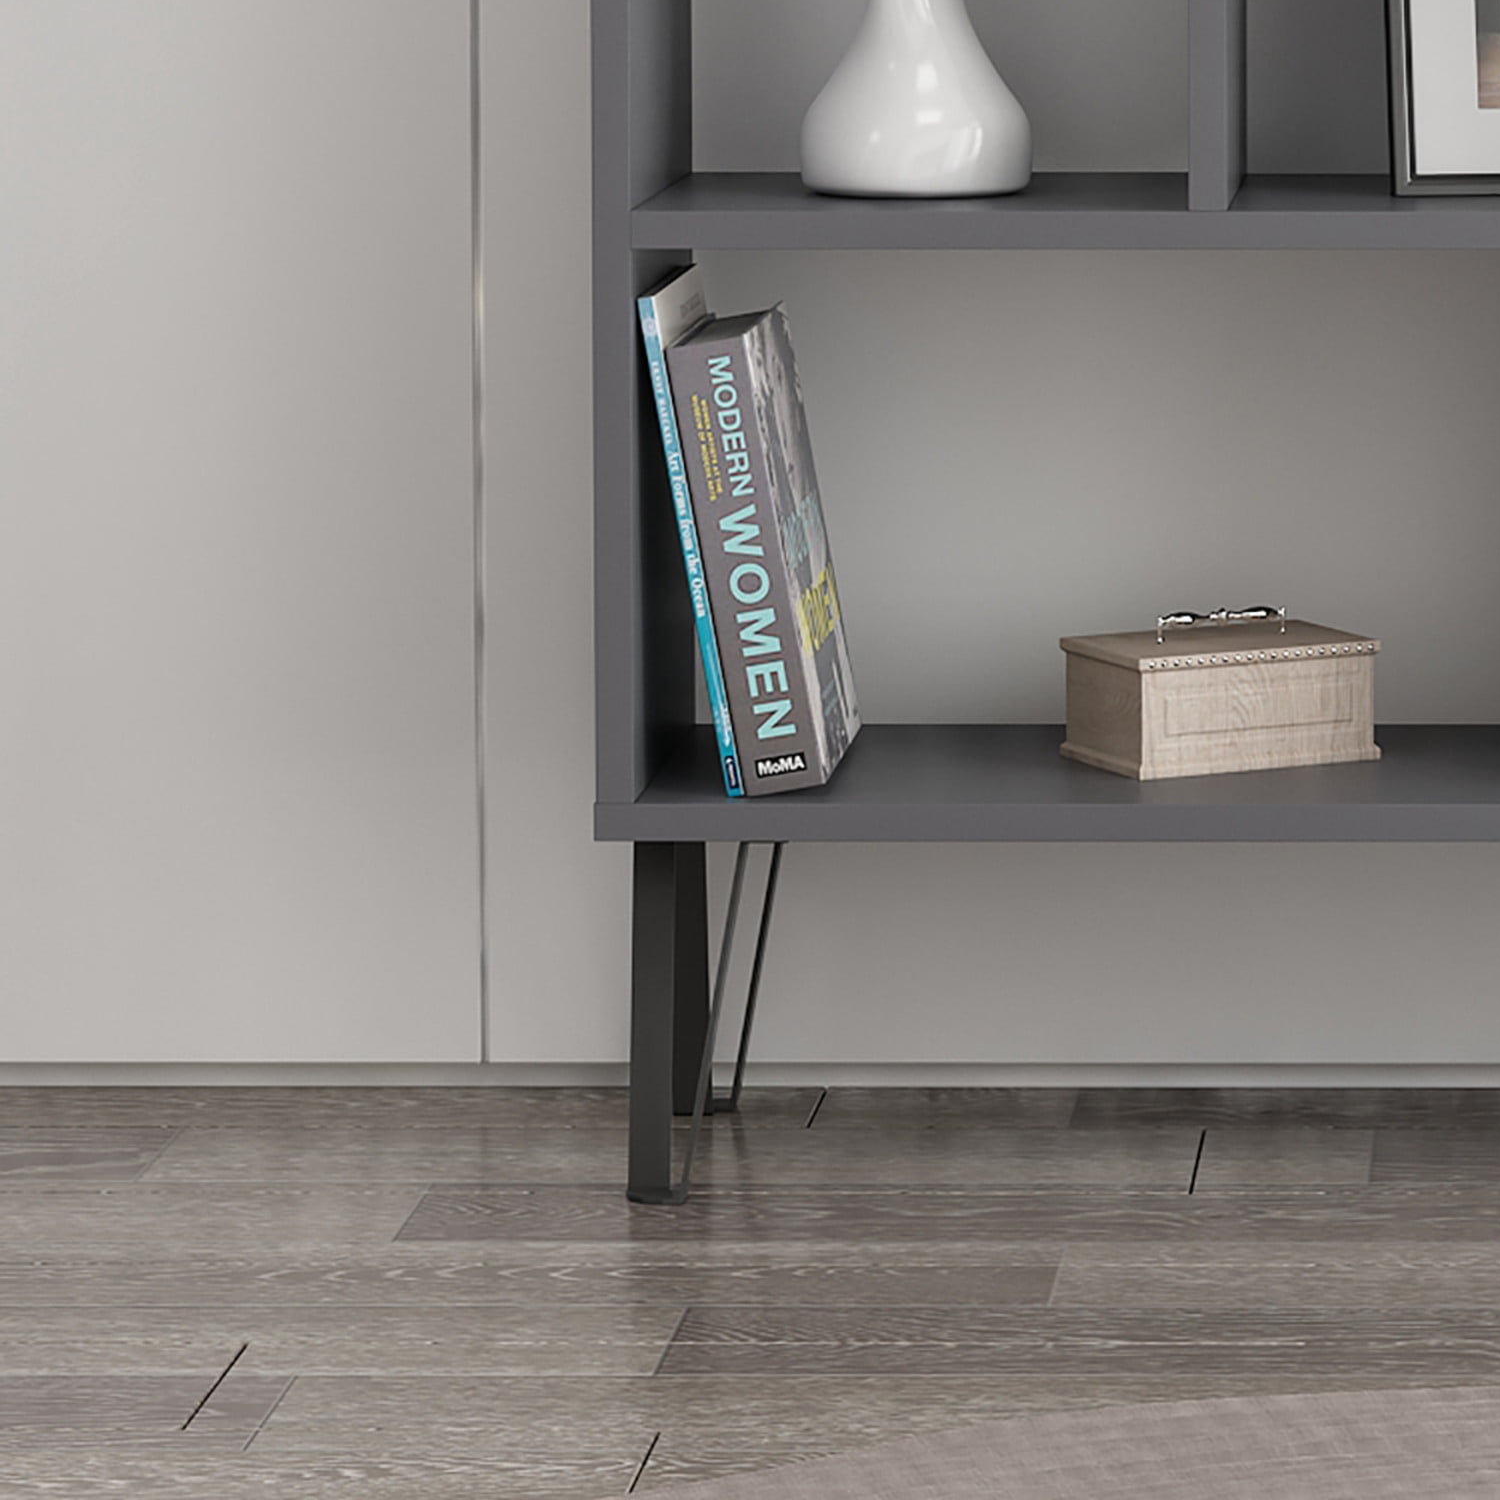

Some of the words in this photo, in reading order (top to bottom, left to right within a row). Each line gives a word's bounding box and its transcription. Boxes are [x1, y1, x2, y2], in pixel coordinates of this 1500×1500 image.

[708, 356, 754, 497] MODERN
[719, 503, 797, 740] WOMEN
[757, 754, 805, 777] MoMA
